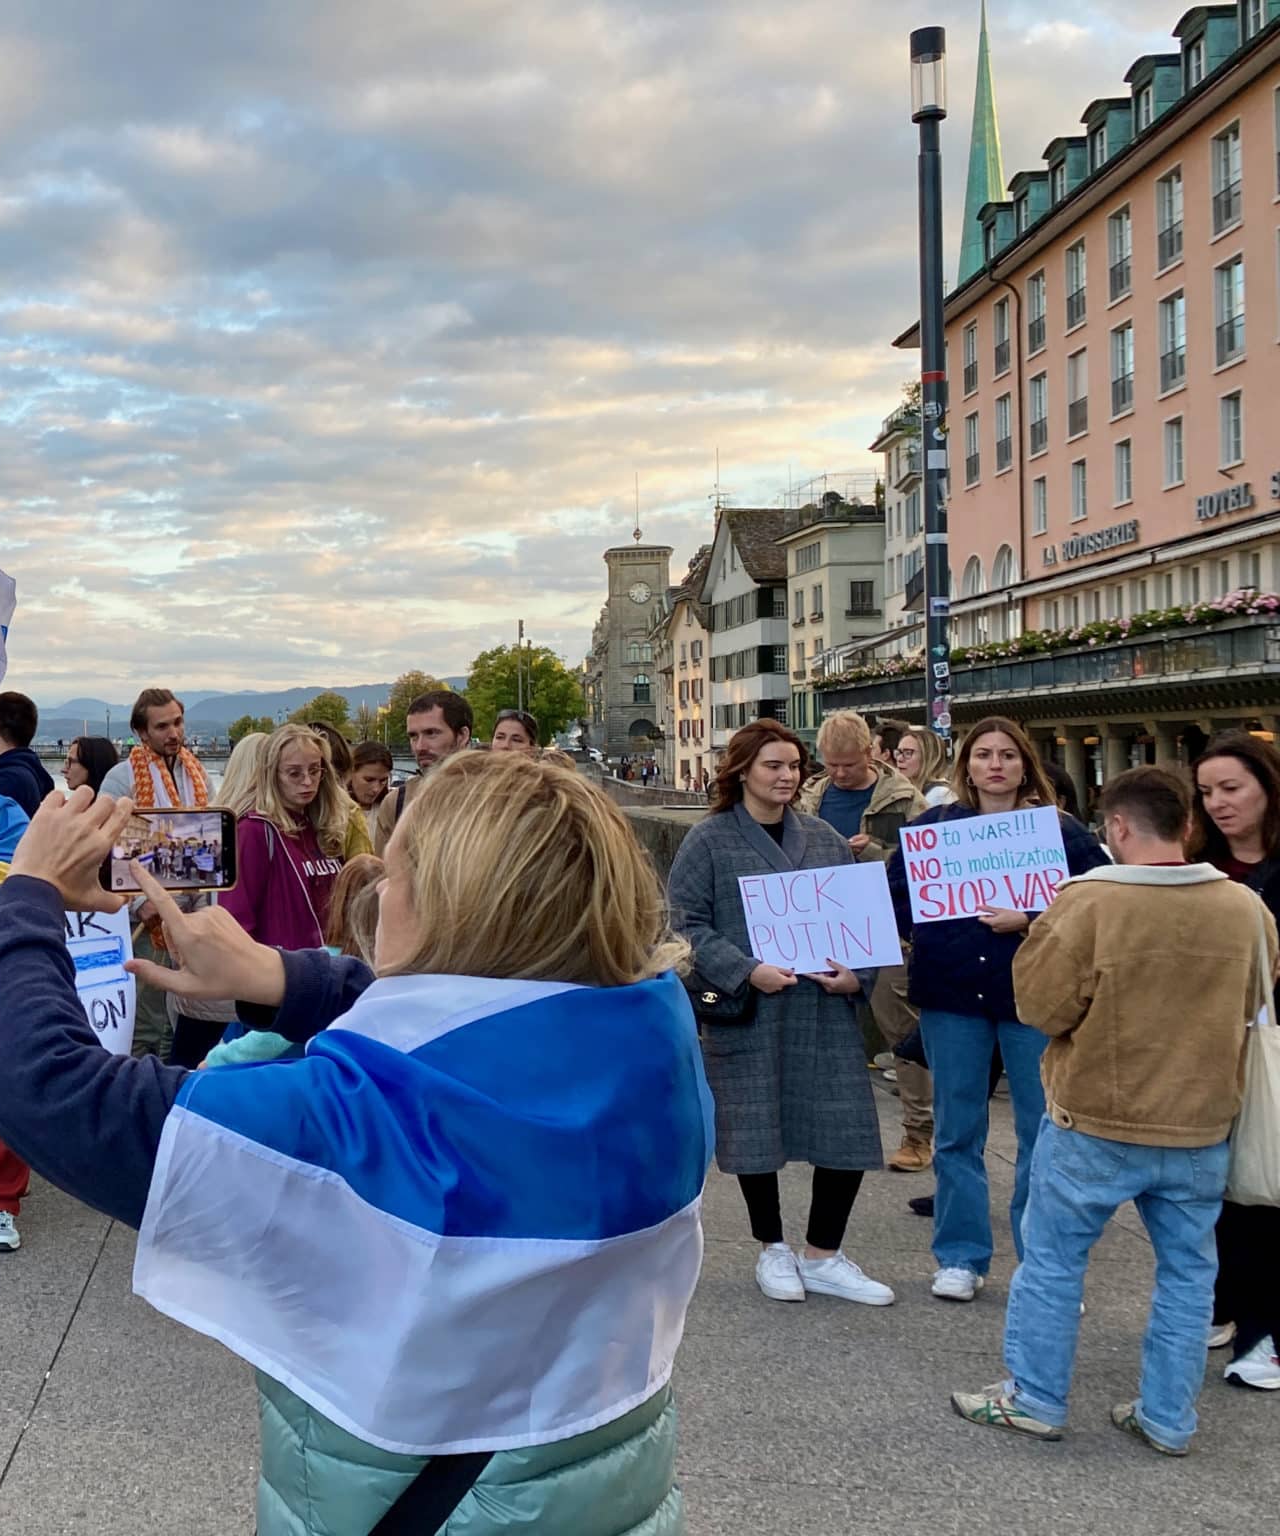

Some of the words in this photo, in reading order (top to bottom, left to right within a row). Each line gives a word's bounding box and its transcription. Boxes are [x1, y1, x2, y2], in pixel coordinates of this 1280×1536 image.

[1196, 482, 1254, 520] HOTEL
[1043, 544, 1059, 567] LA
[905, 828, 938, 853] NO
[942, 826, 961, 847] to
[969, 812, 1036, 842] WAR!!!
[909, 857, 942, 882] NO
[943, 855, 962, 877] to
[742, 871, 846, 917] FUCK
[919, 877, 997, 918] STOP
[1003, 868, 1064, 910] WAR
[752, 915, 873, 963] PUTIN
